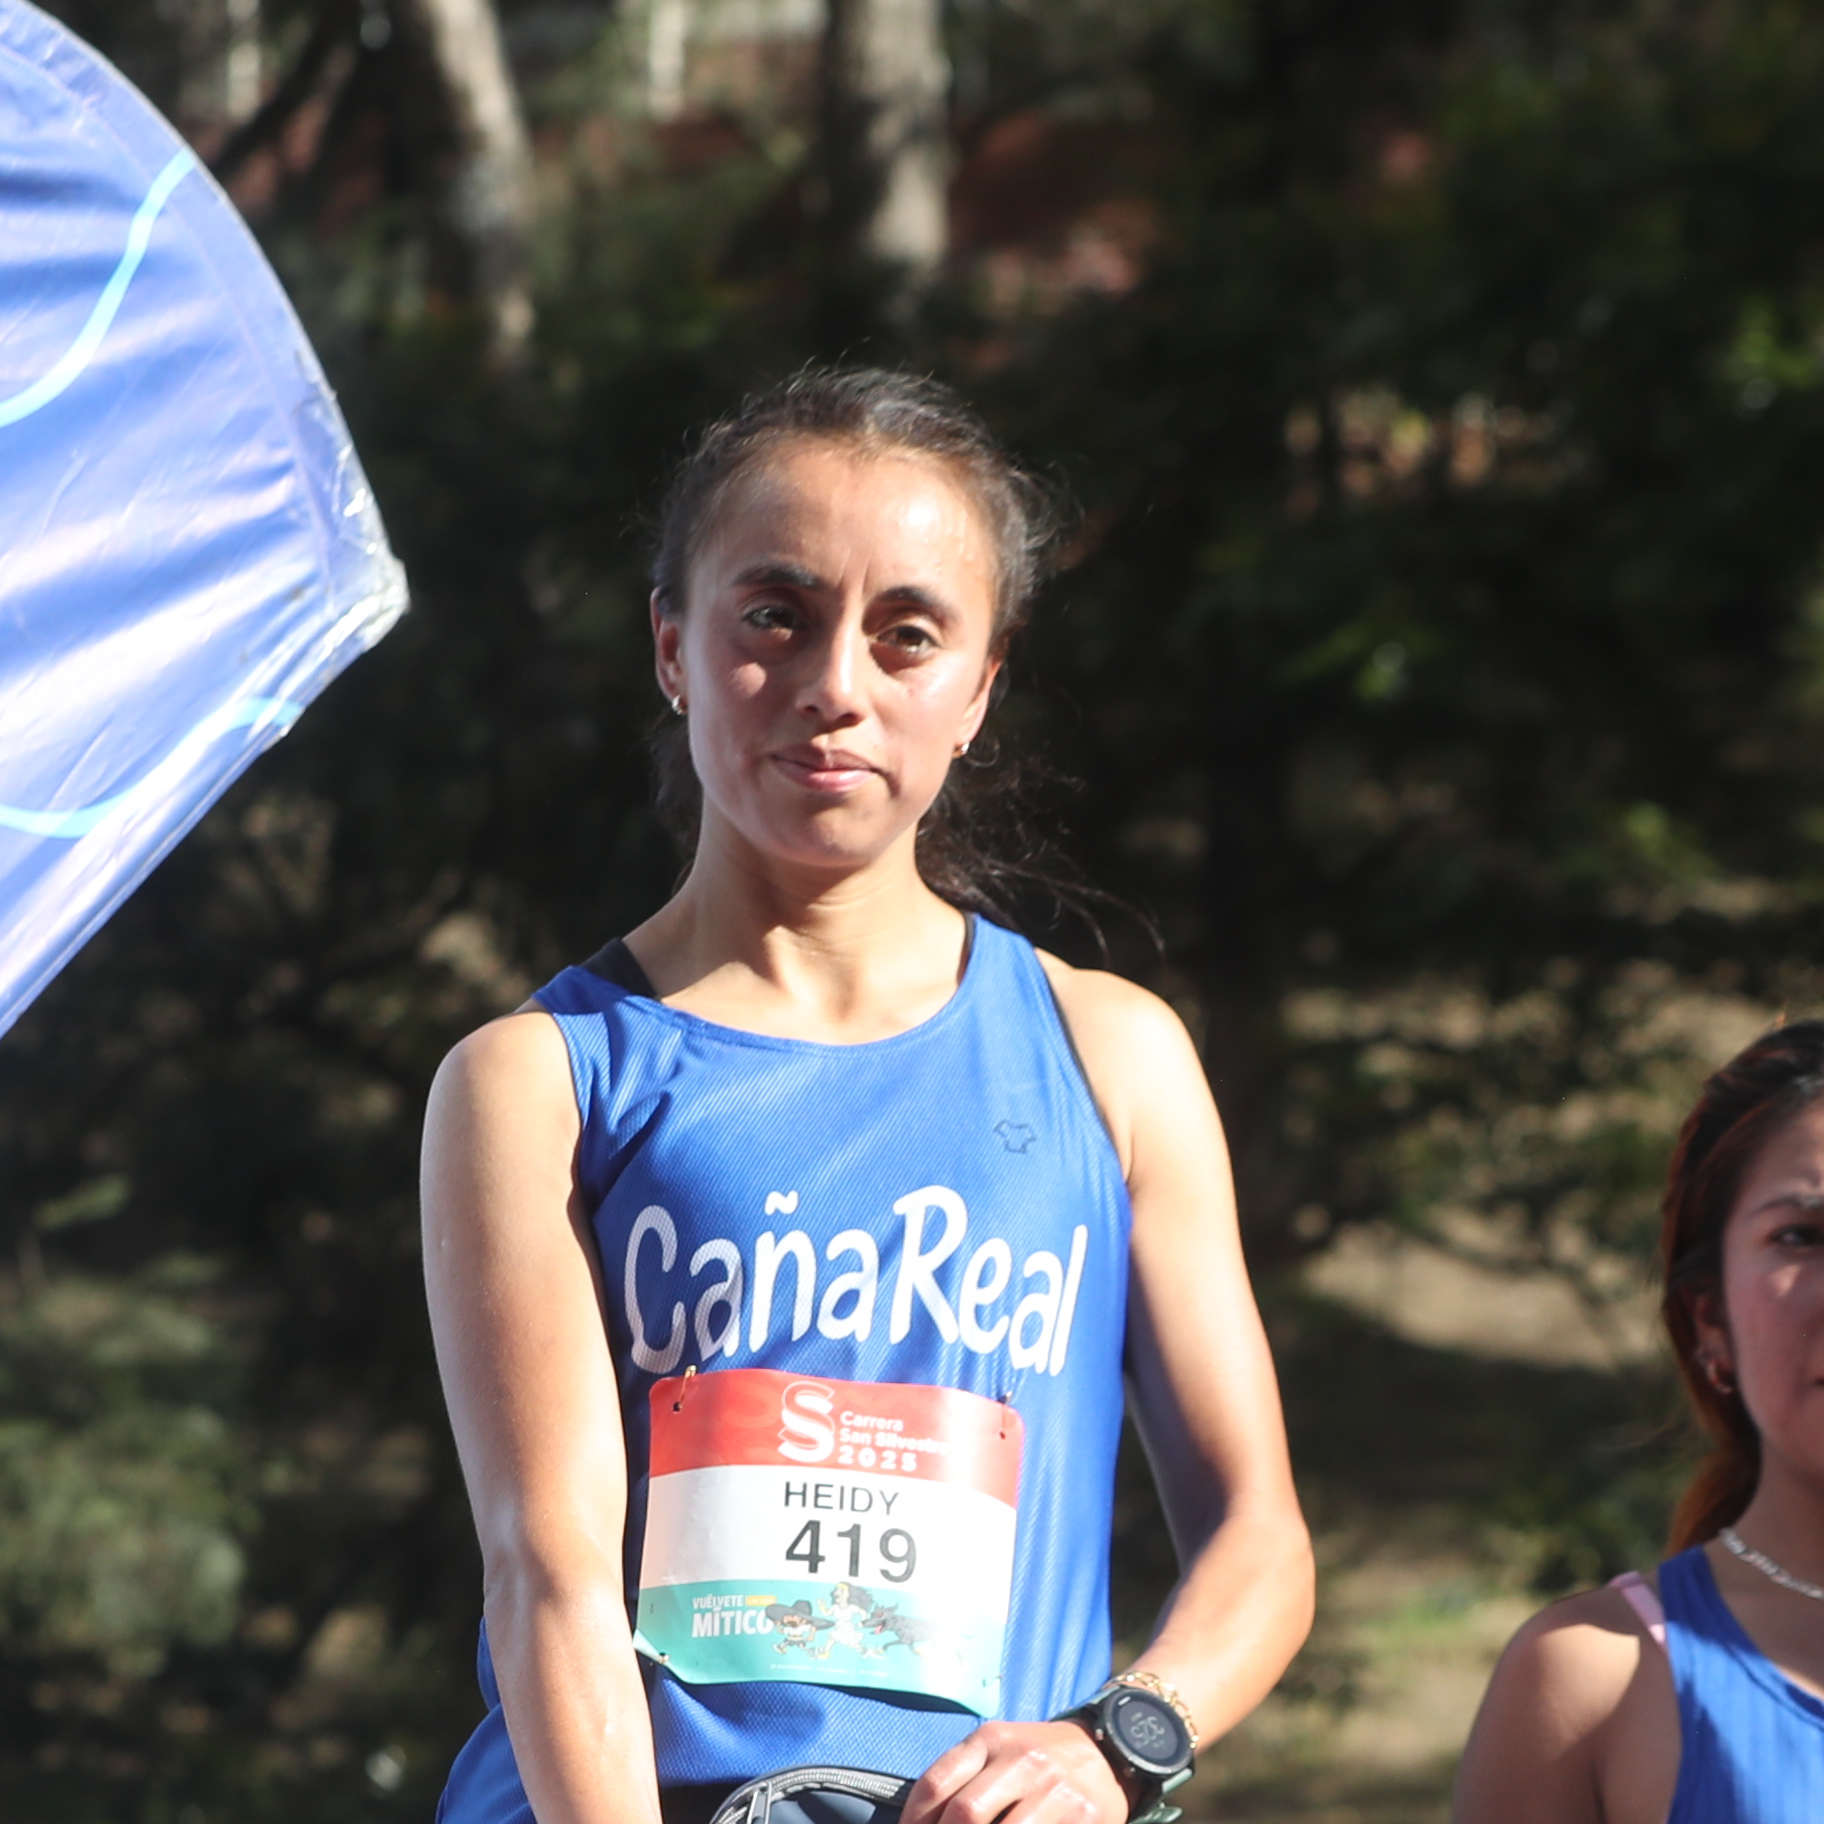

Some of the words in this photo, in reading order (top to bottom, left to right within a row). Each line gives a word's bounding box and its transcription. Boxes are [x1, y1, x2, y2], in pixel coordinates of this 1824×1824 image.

[839, 1410, 904, 1432] Carrera
[839, 1427, 872, 1445] San
[838, 1445, 917, 1472] 2025
[784, 1480, 900, 1517] HEIDY
[785, 1518, 917, 1584] 419
[691, 1605, 775, 1638] MÍTICO
